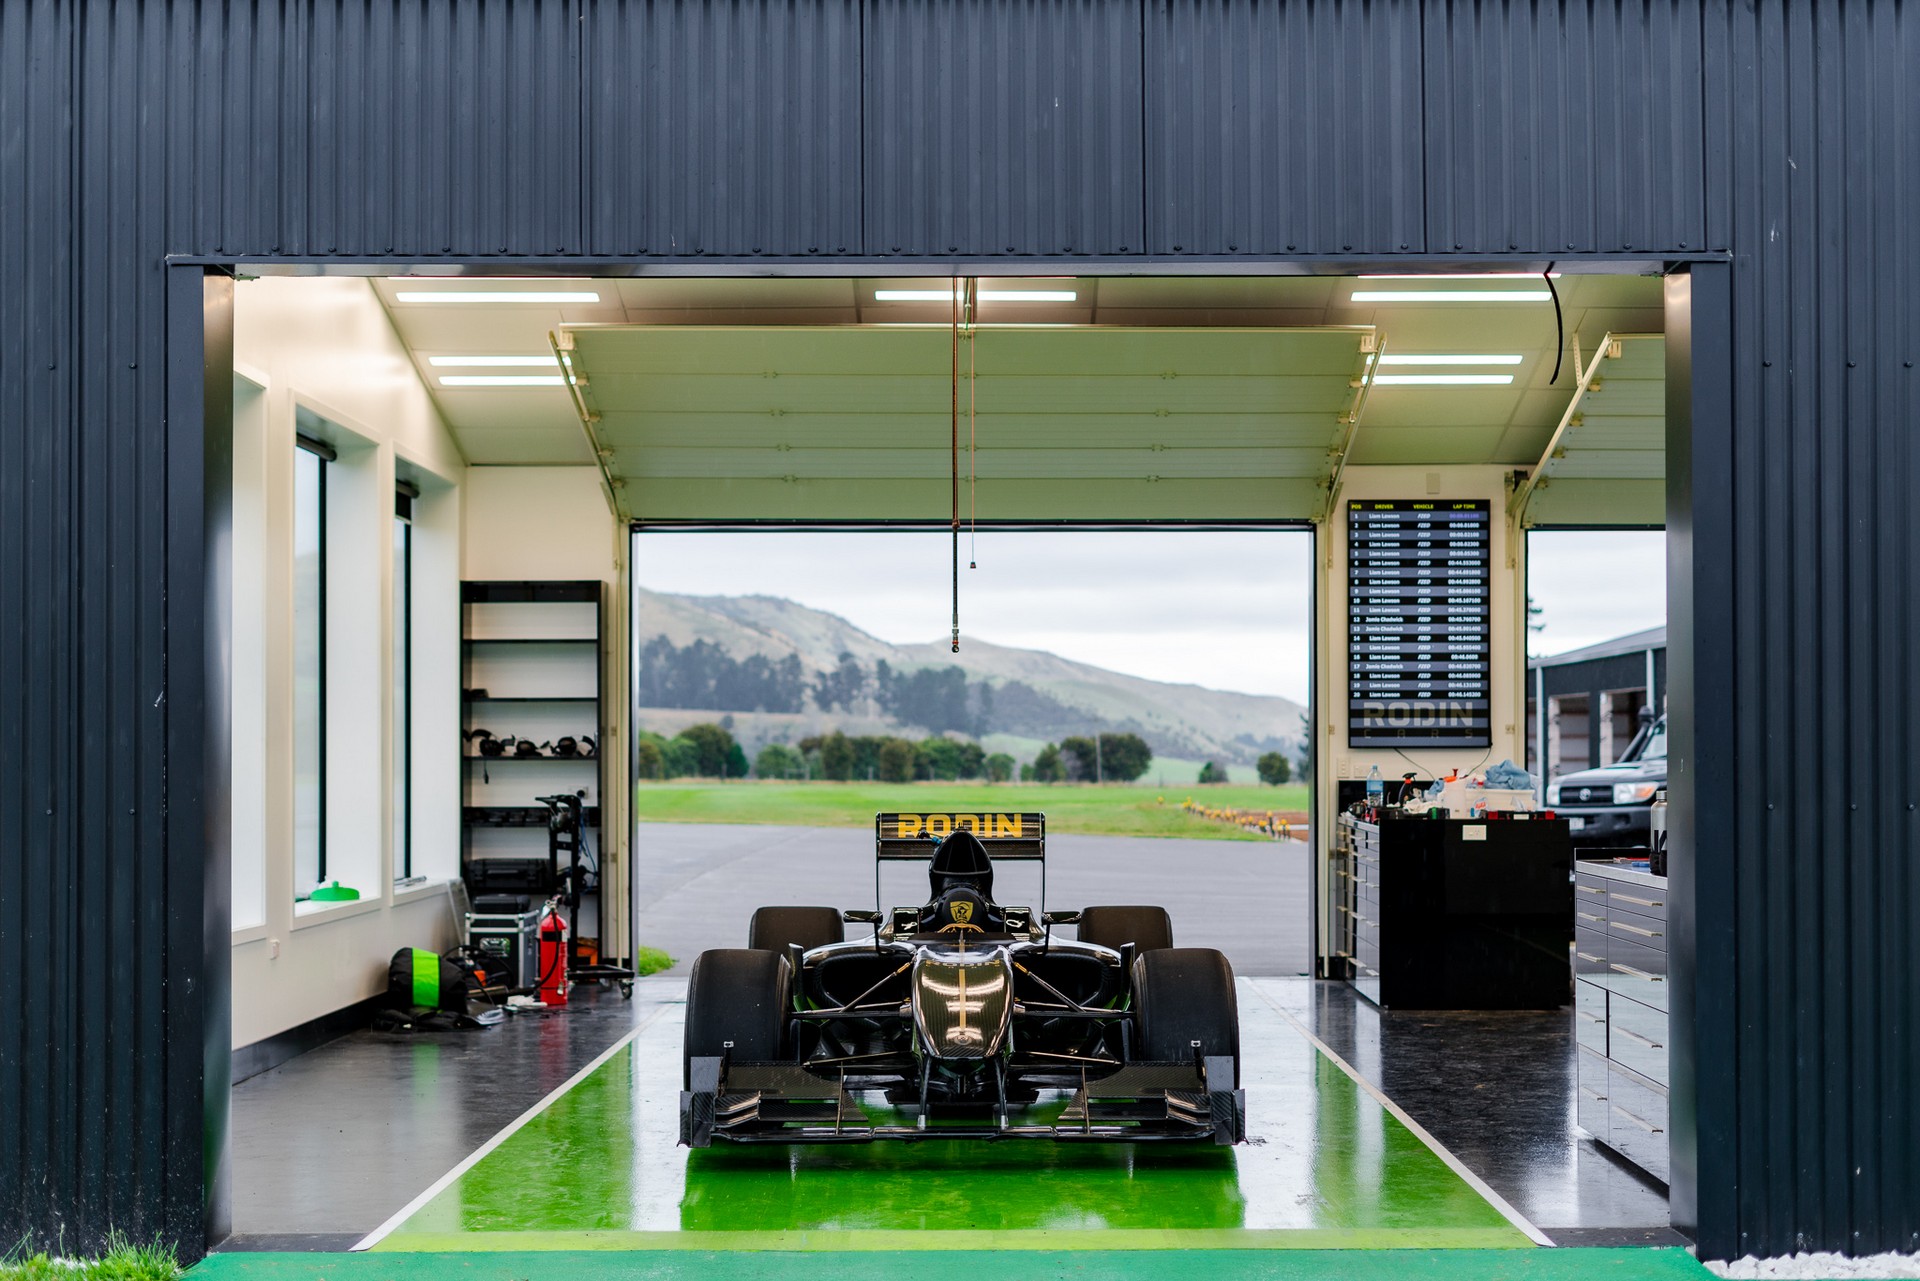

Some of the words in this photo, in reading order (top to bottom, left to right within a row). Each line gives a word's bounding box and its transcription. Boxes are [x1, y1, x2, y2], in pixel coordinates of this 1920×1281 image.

[1363, 702, 1473, 726] RODIN
[1363, 729, 1473, 739] CARS
[897, 813, 1023, 839] RODIN
